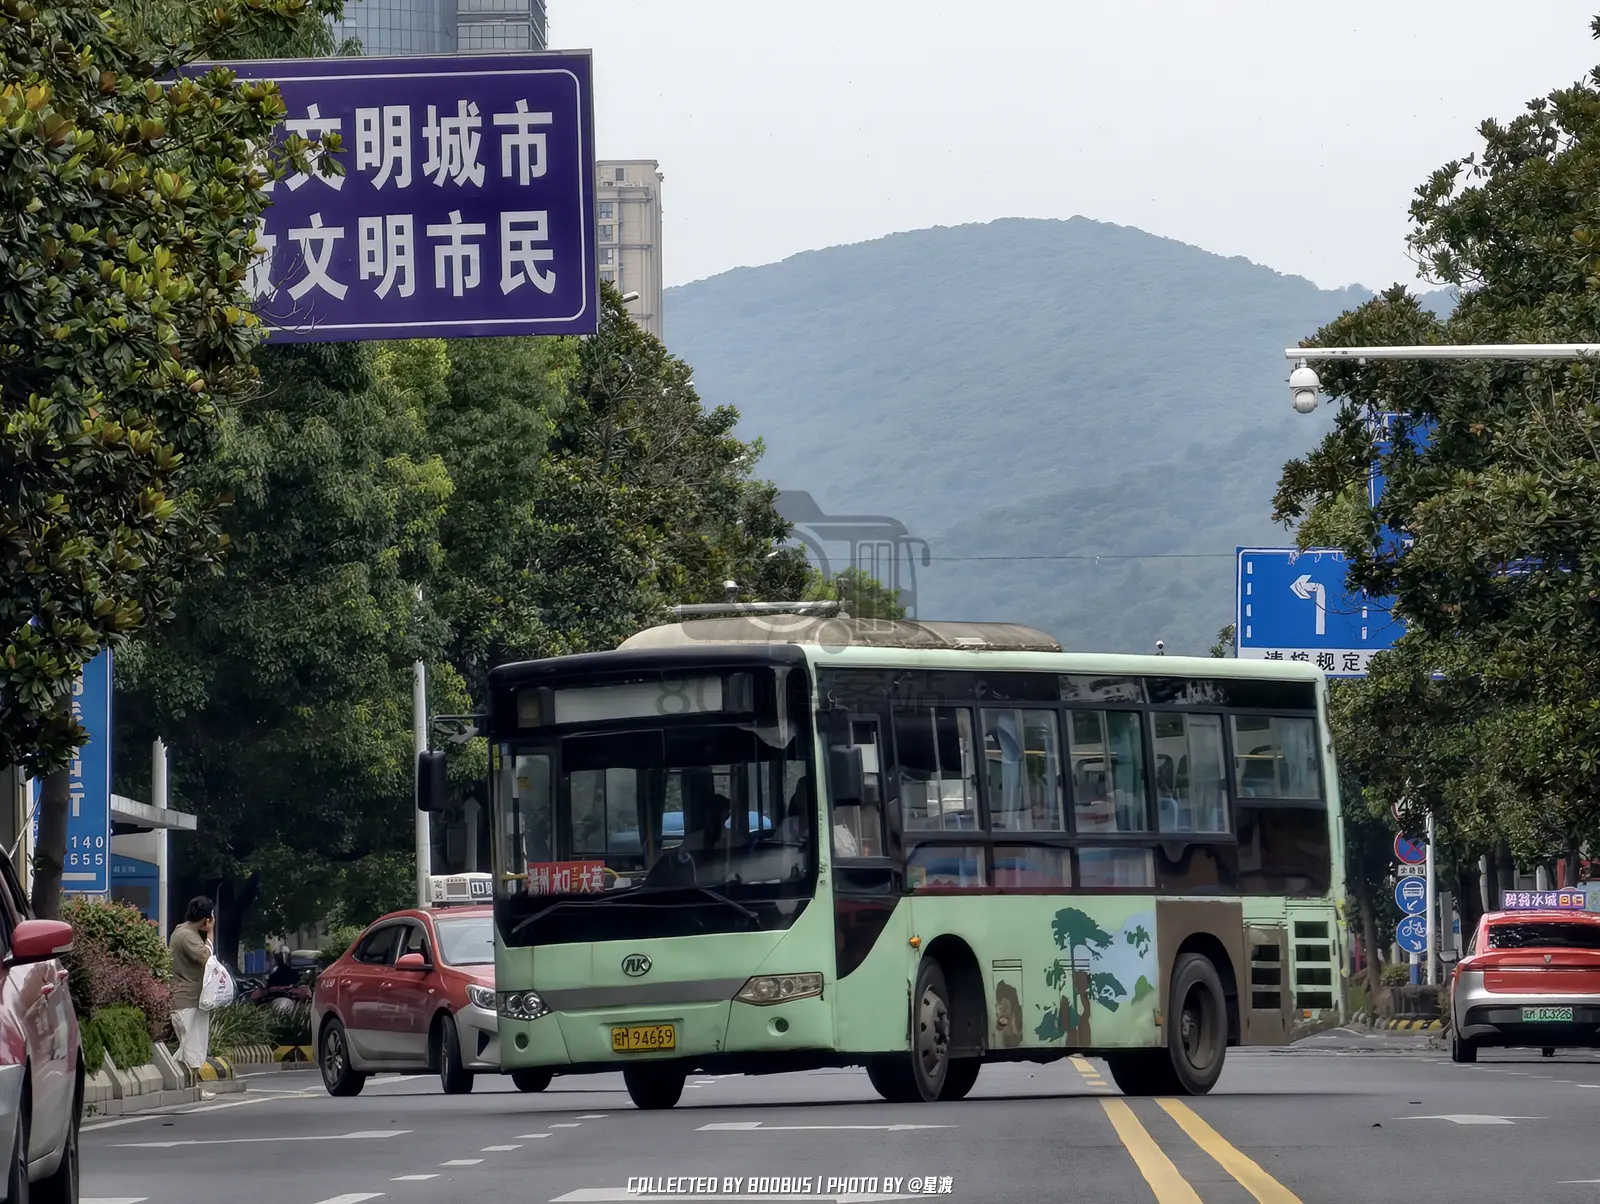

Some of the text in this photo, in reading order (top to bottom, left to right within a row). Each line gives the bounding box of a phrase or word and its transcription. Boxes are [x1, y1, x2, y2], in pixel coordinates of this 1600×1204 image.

[246, 98, 553, 191] 文明城市
[64, 853, 103, 865] 555
